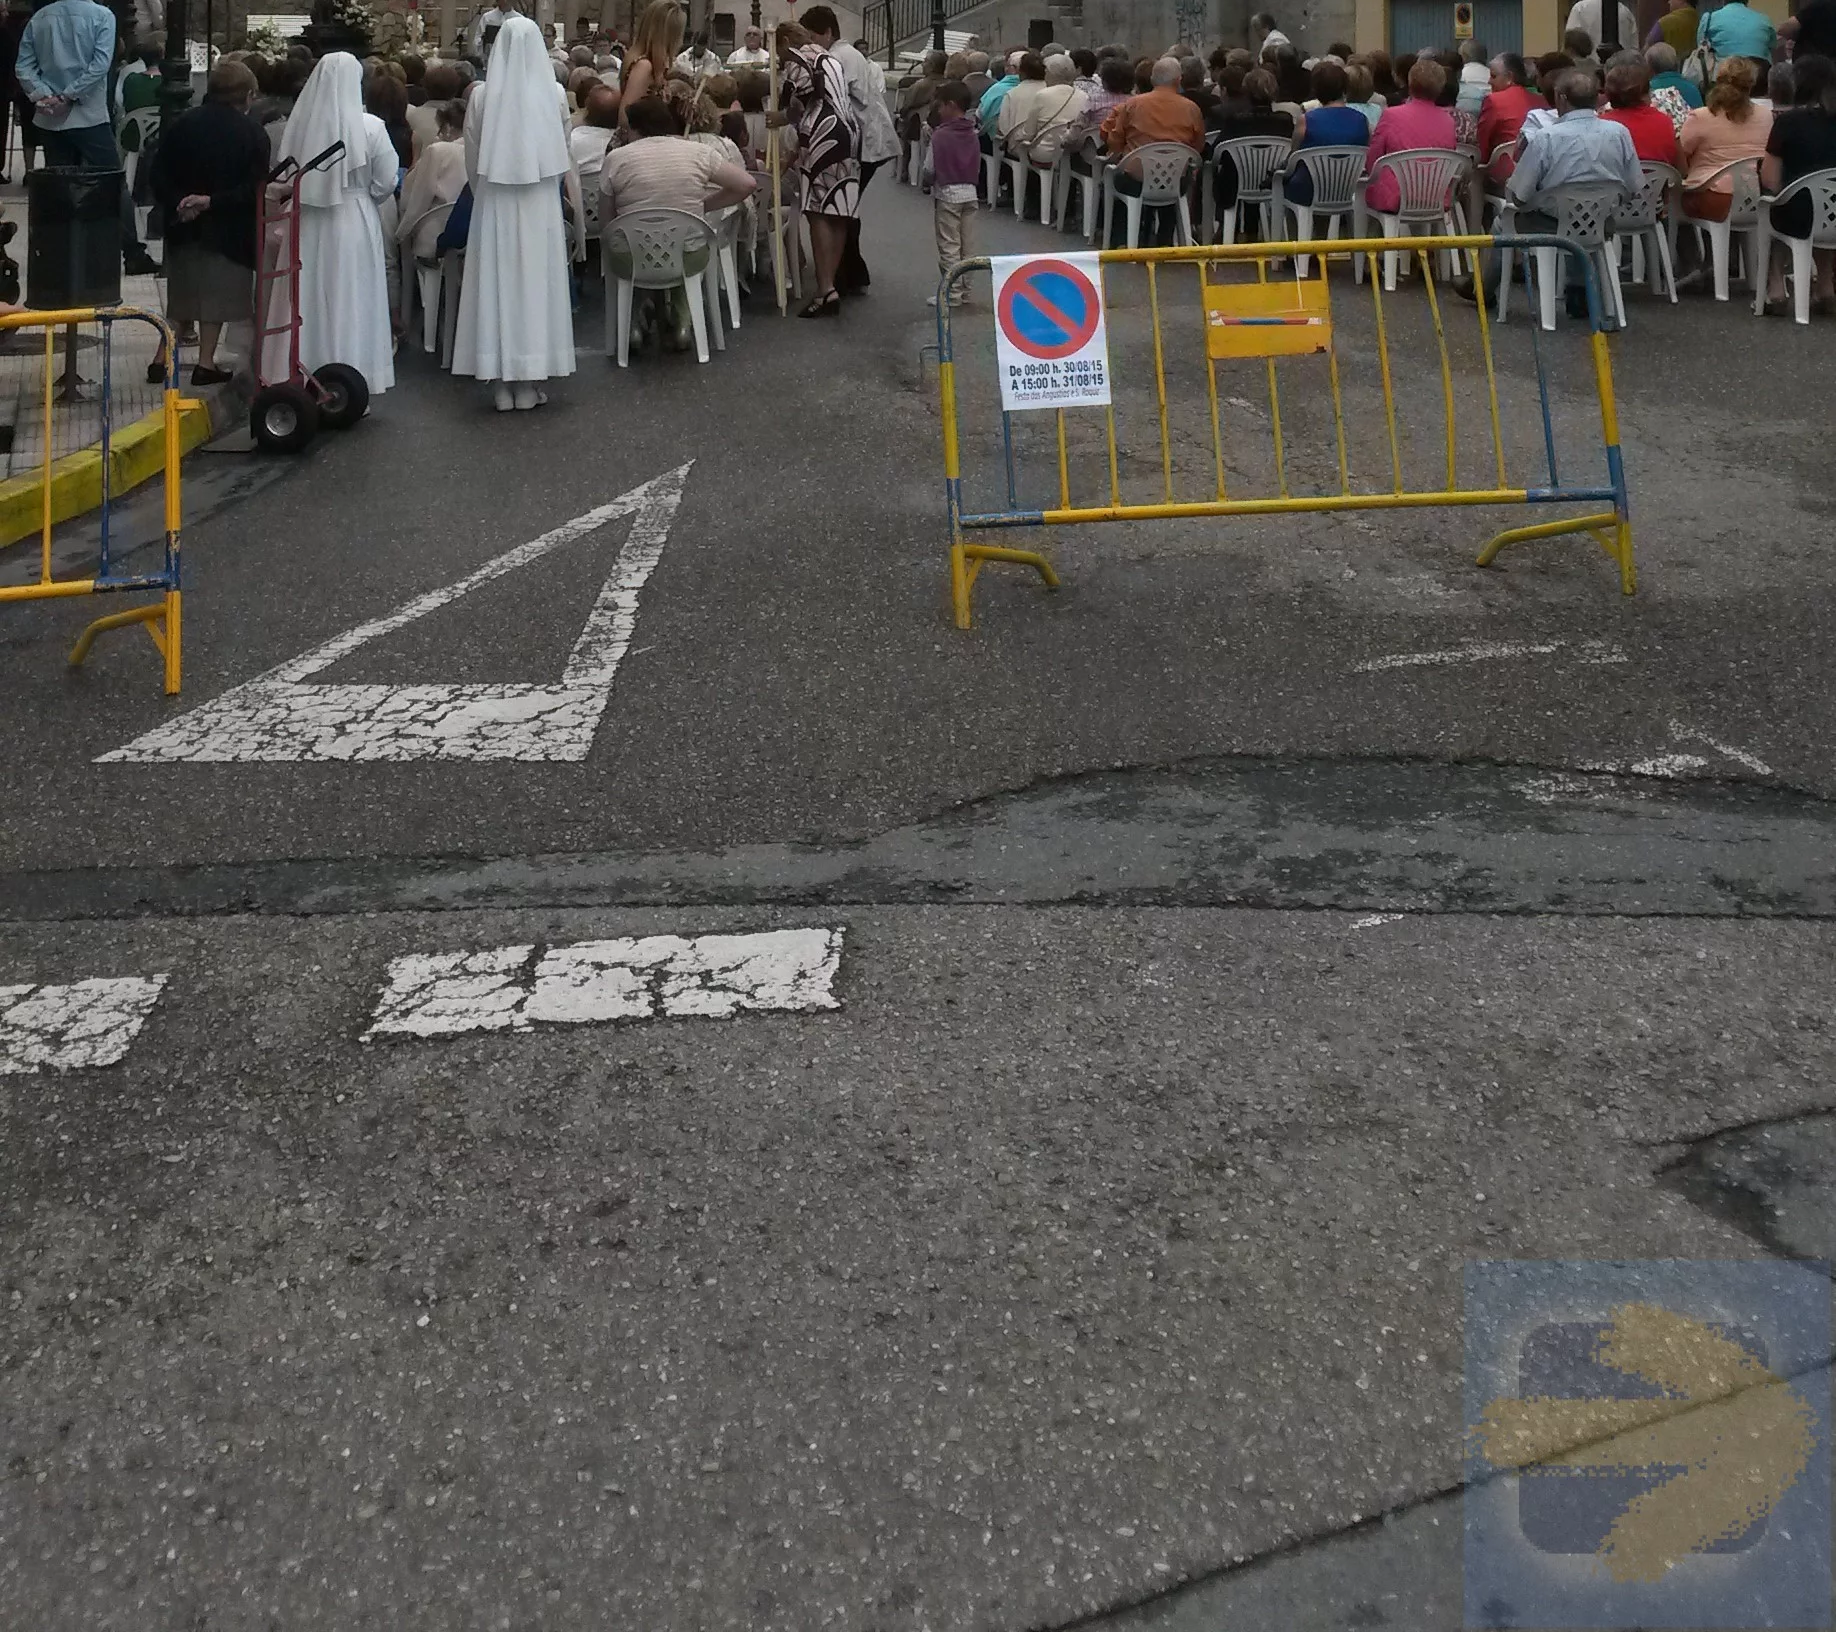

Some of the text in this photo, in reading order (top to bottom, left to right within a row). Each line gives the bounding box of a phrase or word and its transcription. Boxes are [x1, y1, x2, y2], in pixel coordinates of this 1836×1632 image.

[1010, 360, 1102, 376] De 09:00 h. 30/08/15
[1012, 374, 1104, 390] A 15:00 h. 31/08/15
